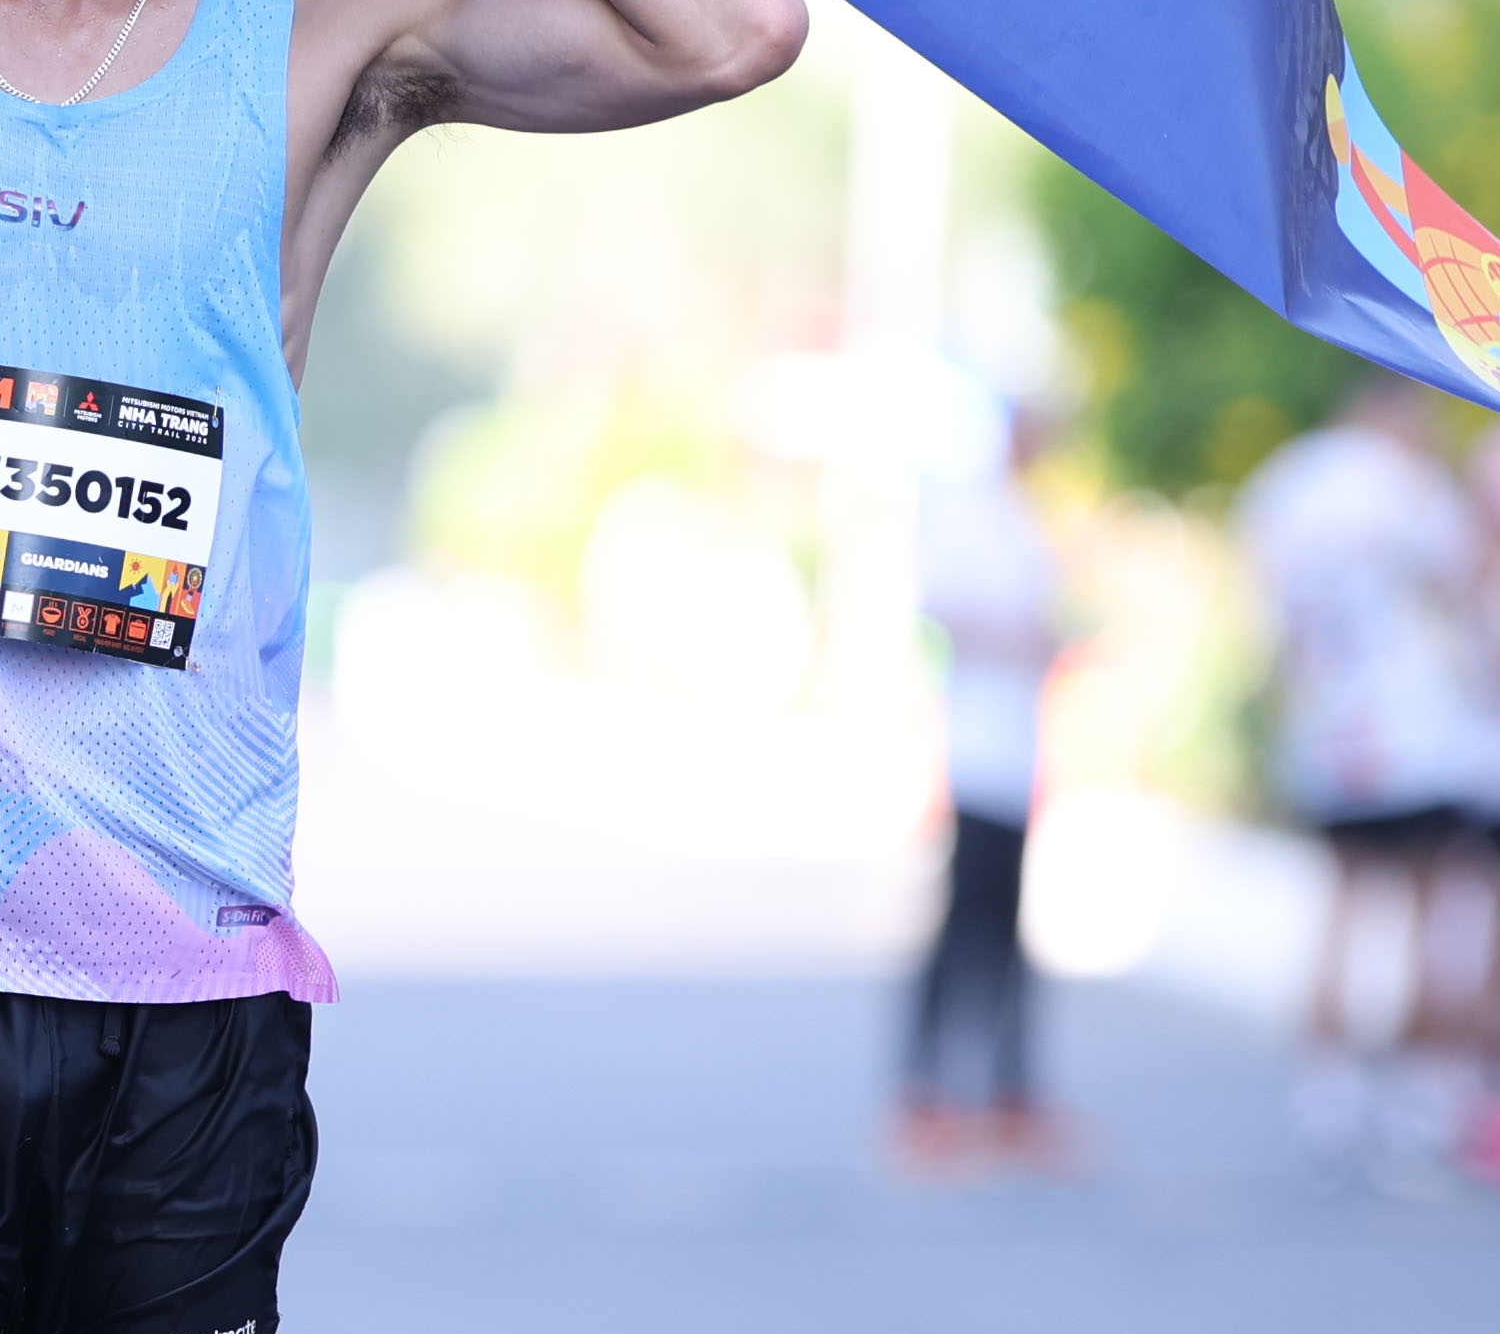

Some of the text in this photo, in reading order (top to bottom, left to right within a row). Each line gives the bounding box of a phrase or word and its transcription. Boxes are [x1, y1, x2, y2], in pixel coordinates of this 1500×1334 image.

[121, 396, 160, 410] MITSUBISHI
[160, 403, 186, 416] MOTORS
[117, 420, 145, 431] CITY
[151, 427, 181, 439] TRAIL
[118, 404, 209, 436] NHA TRANG
[20, 552, 109, 579] GUARDIANS
